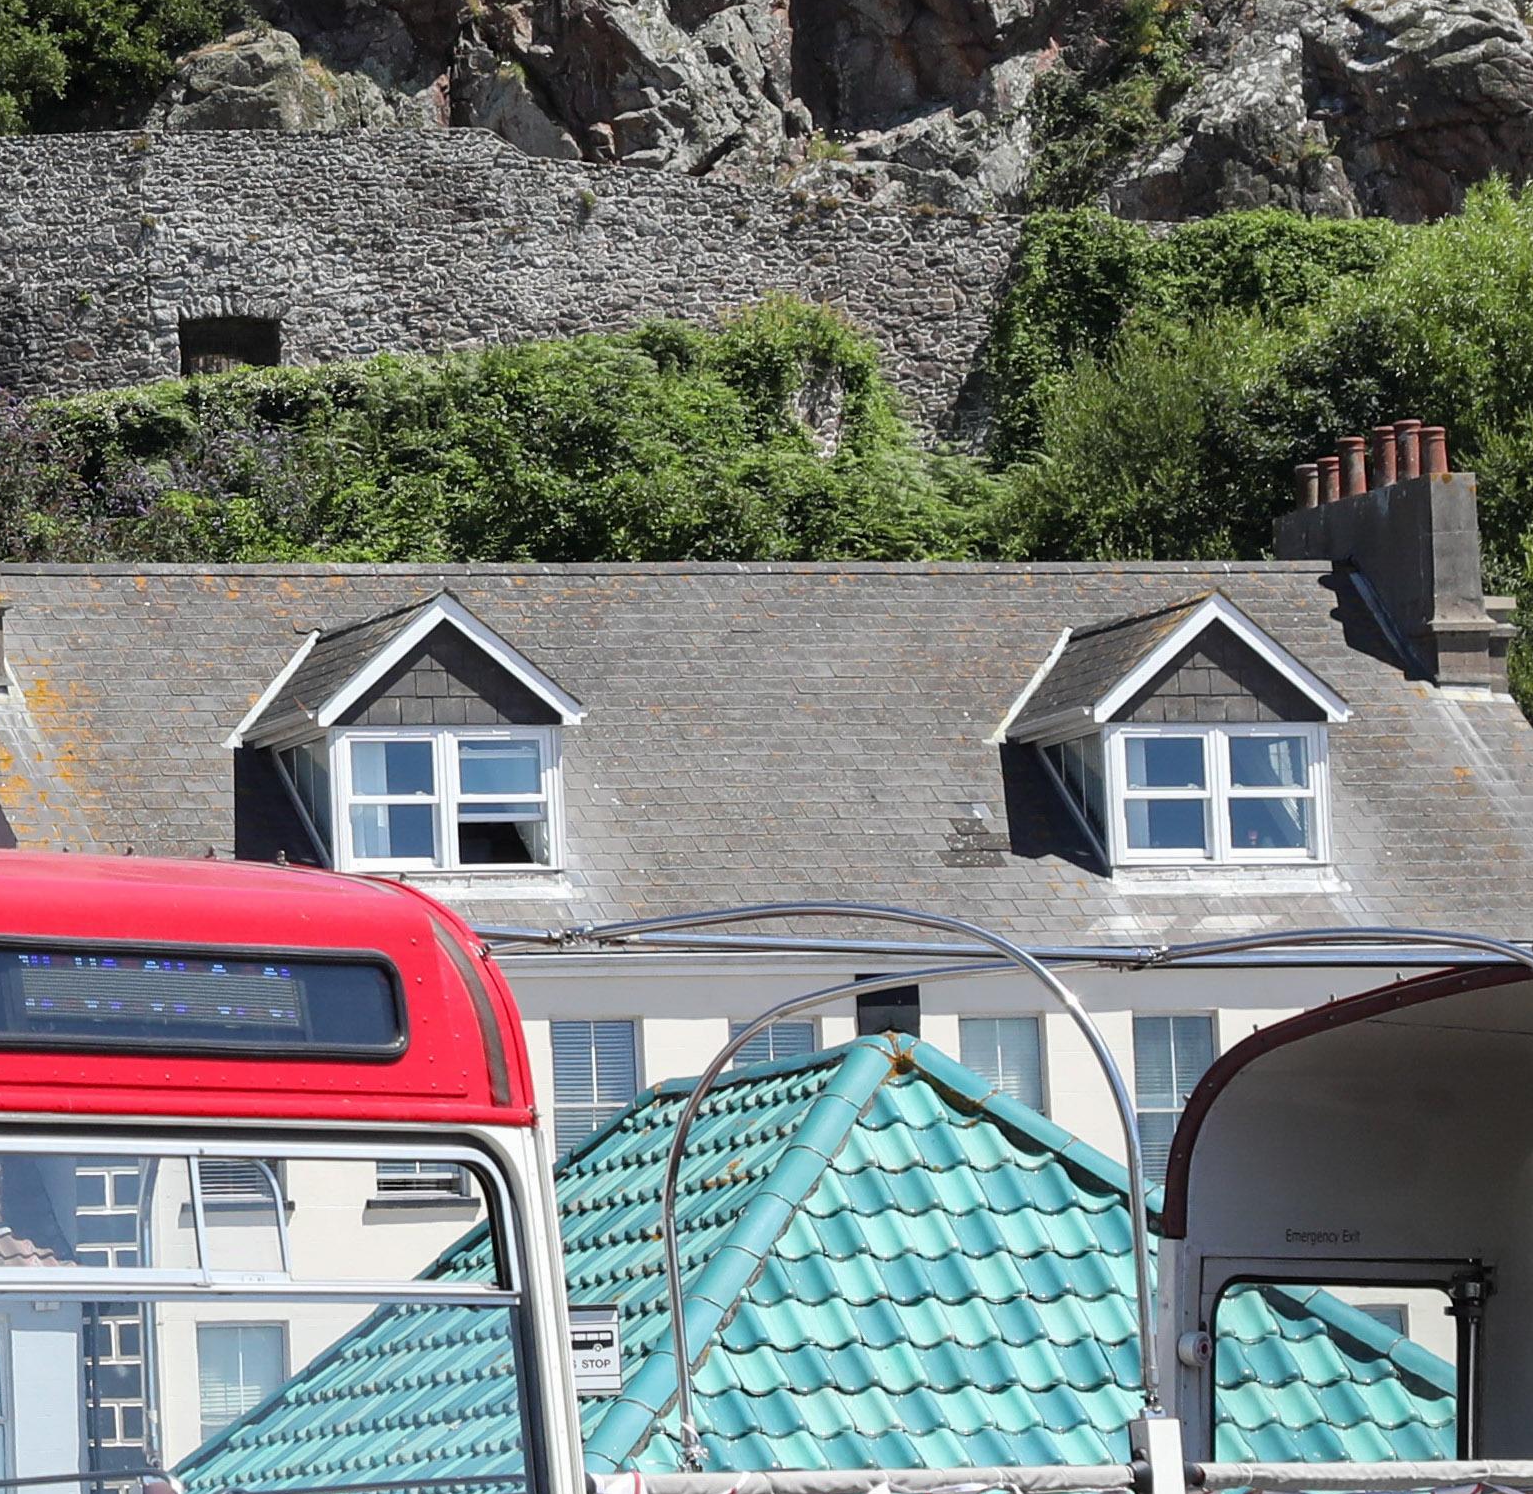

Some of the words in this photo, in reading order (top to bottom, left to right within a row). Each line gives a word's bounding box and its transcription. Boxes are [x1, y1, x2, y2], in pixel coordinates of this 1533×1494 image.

[1285, 1228, 1338, 1245] Emergency
[1342, 1229, 1360, 1243] Exit
[582, 1359, 611, 1369] STOP
